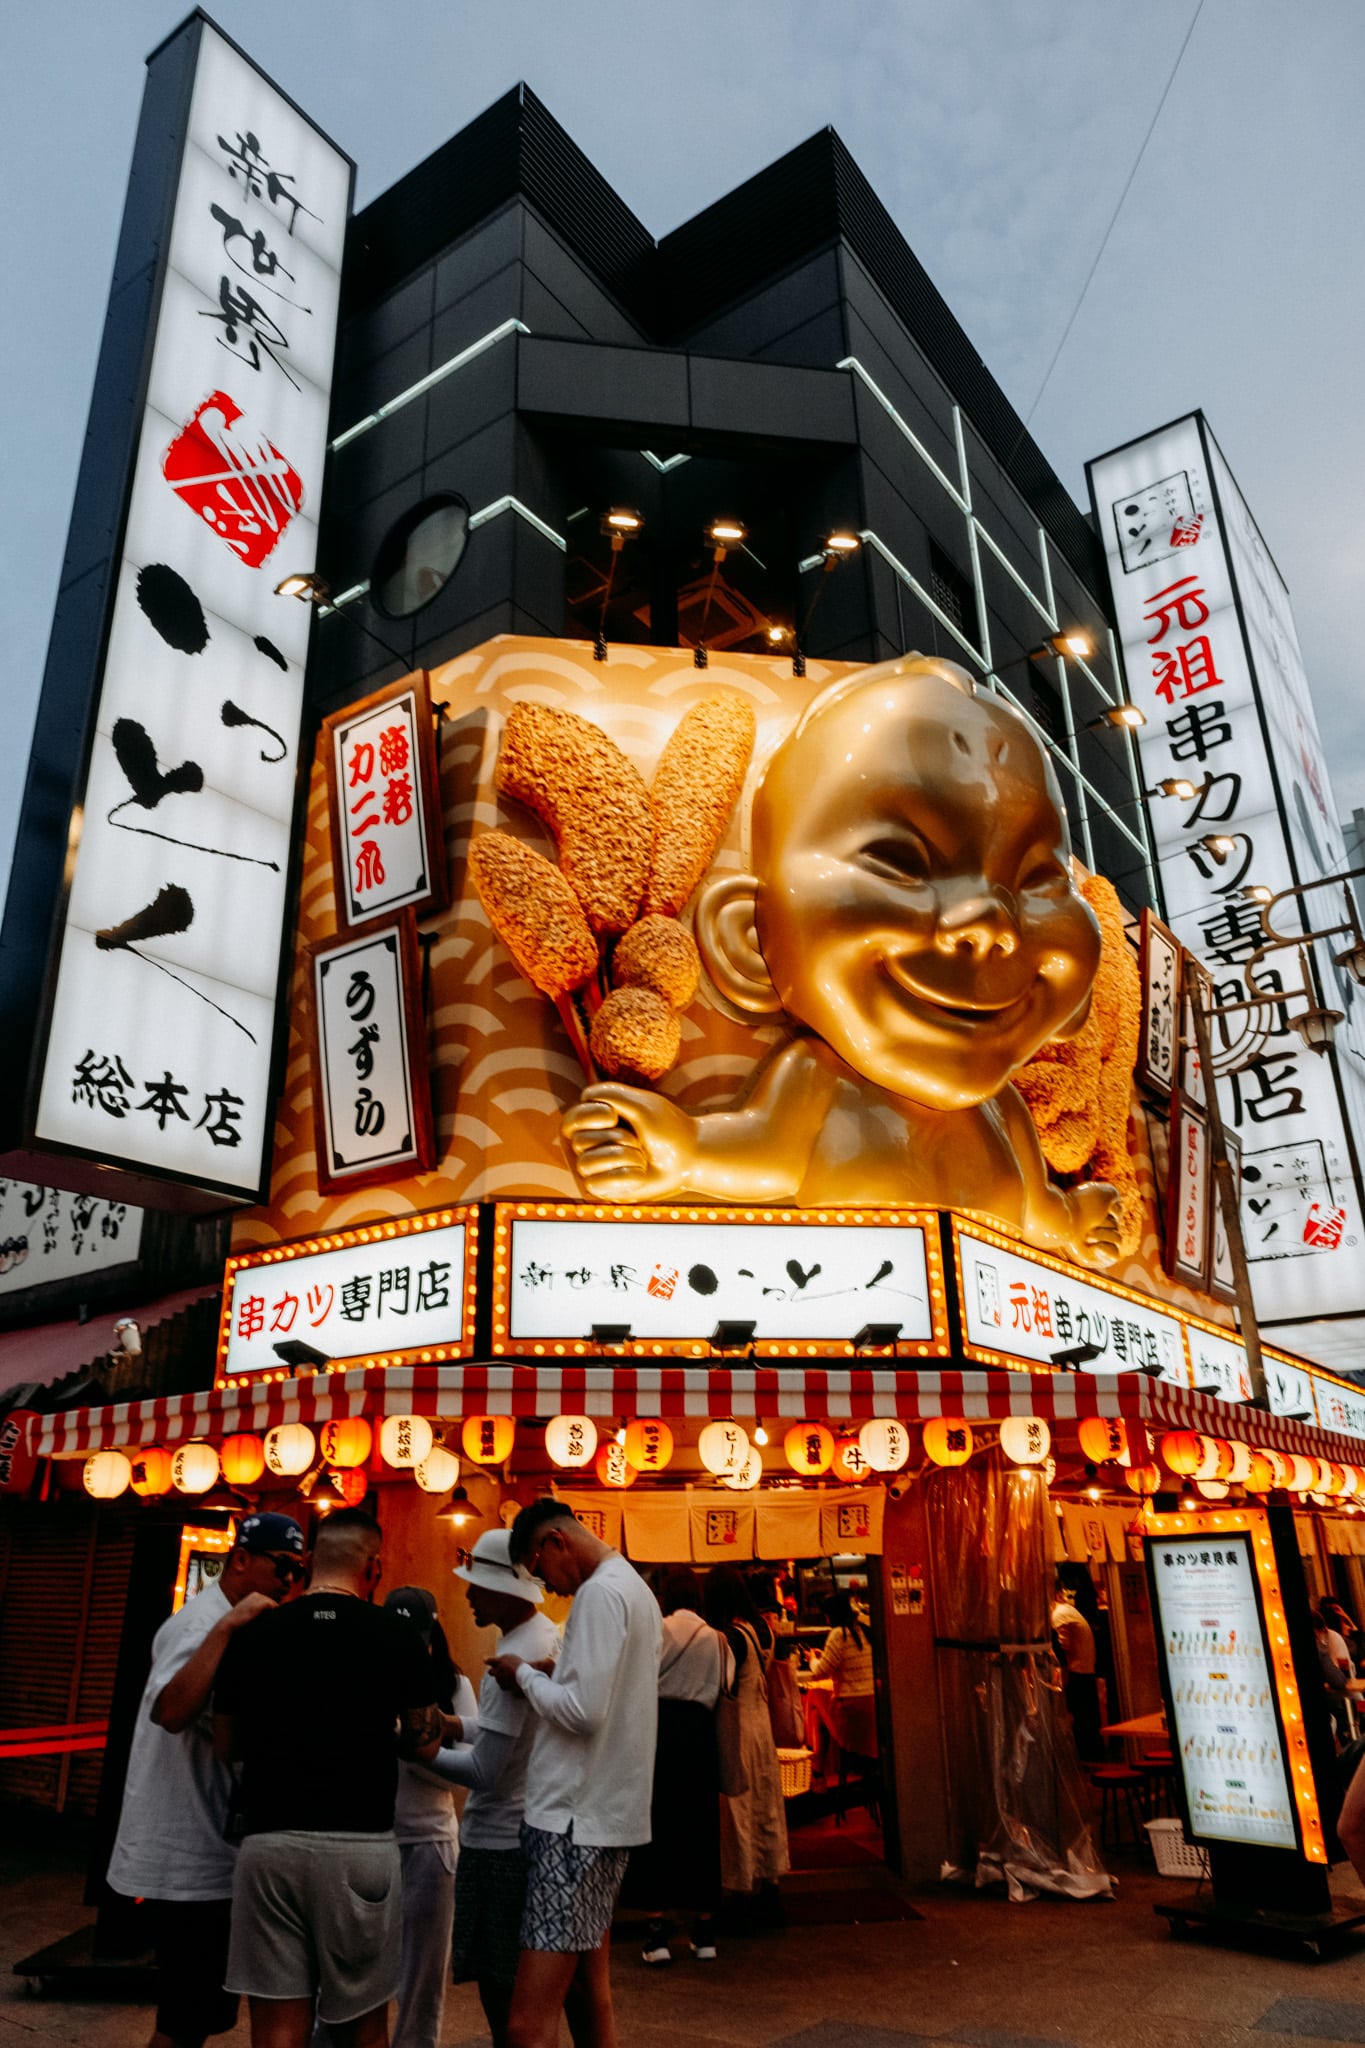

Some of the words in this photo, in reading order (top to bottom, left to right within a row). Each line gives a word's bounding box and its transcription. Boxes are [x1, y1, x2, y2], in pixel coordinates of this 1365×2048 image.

[72, 1049, 245, 1147] 総本店
[345, 970, 385, 1137] うずら
[236, 1260, 452, 1342] 串カツ専門店
[1008, 1281, 1161, 1369] 元祖串カツ専門店
